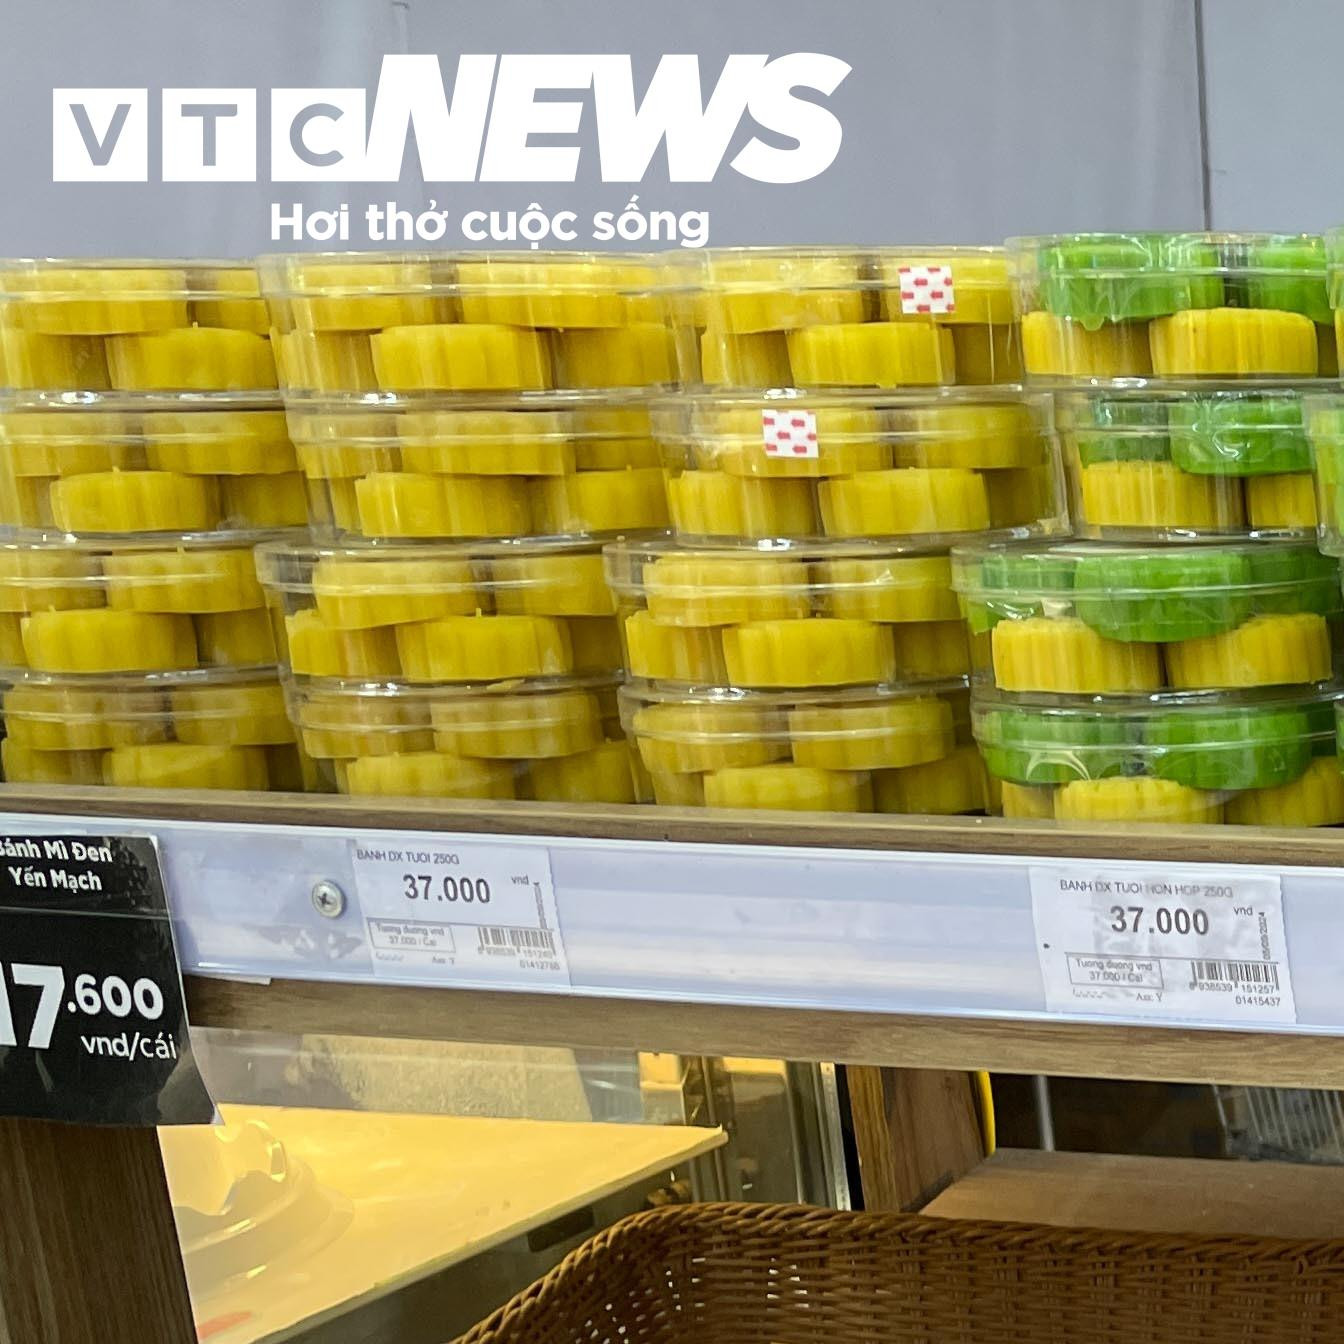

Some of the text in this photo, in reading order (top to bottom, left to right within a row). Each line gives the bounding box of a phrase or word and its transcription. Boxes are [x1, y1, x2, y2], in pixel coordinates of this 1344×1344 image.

[43, 840, 69, 860] Mì
[71, 842, 113, 862] Đen
[357, 850, 386, 861] BANH
[389, 852, 402, 861] DX
[407, 853, 431, 863] TUOI
[8, 866, 102, 893] Yến Mạch
[403, 874, 490, 903] 37.000
[511, 876, 529, 885] vnd
[1060, 879, 1092, 891] BANH
[1095, 882, 1112, 892] DX
[1114, 882, 1143, 894] TUOI
[1110, 905, 1209, 936] 37.000
[1233, 906, 1253, 916] vnd
[81, 1032, 176, 1061] vnd/cái
